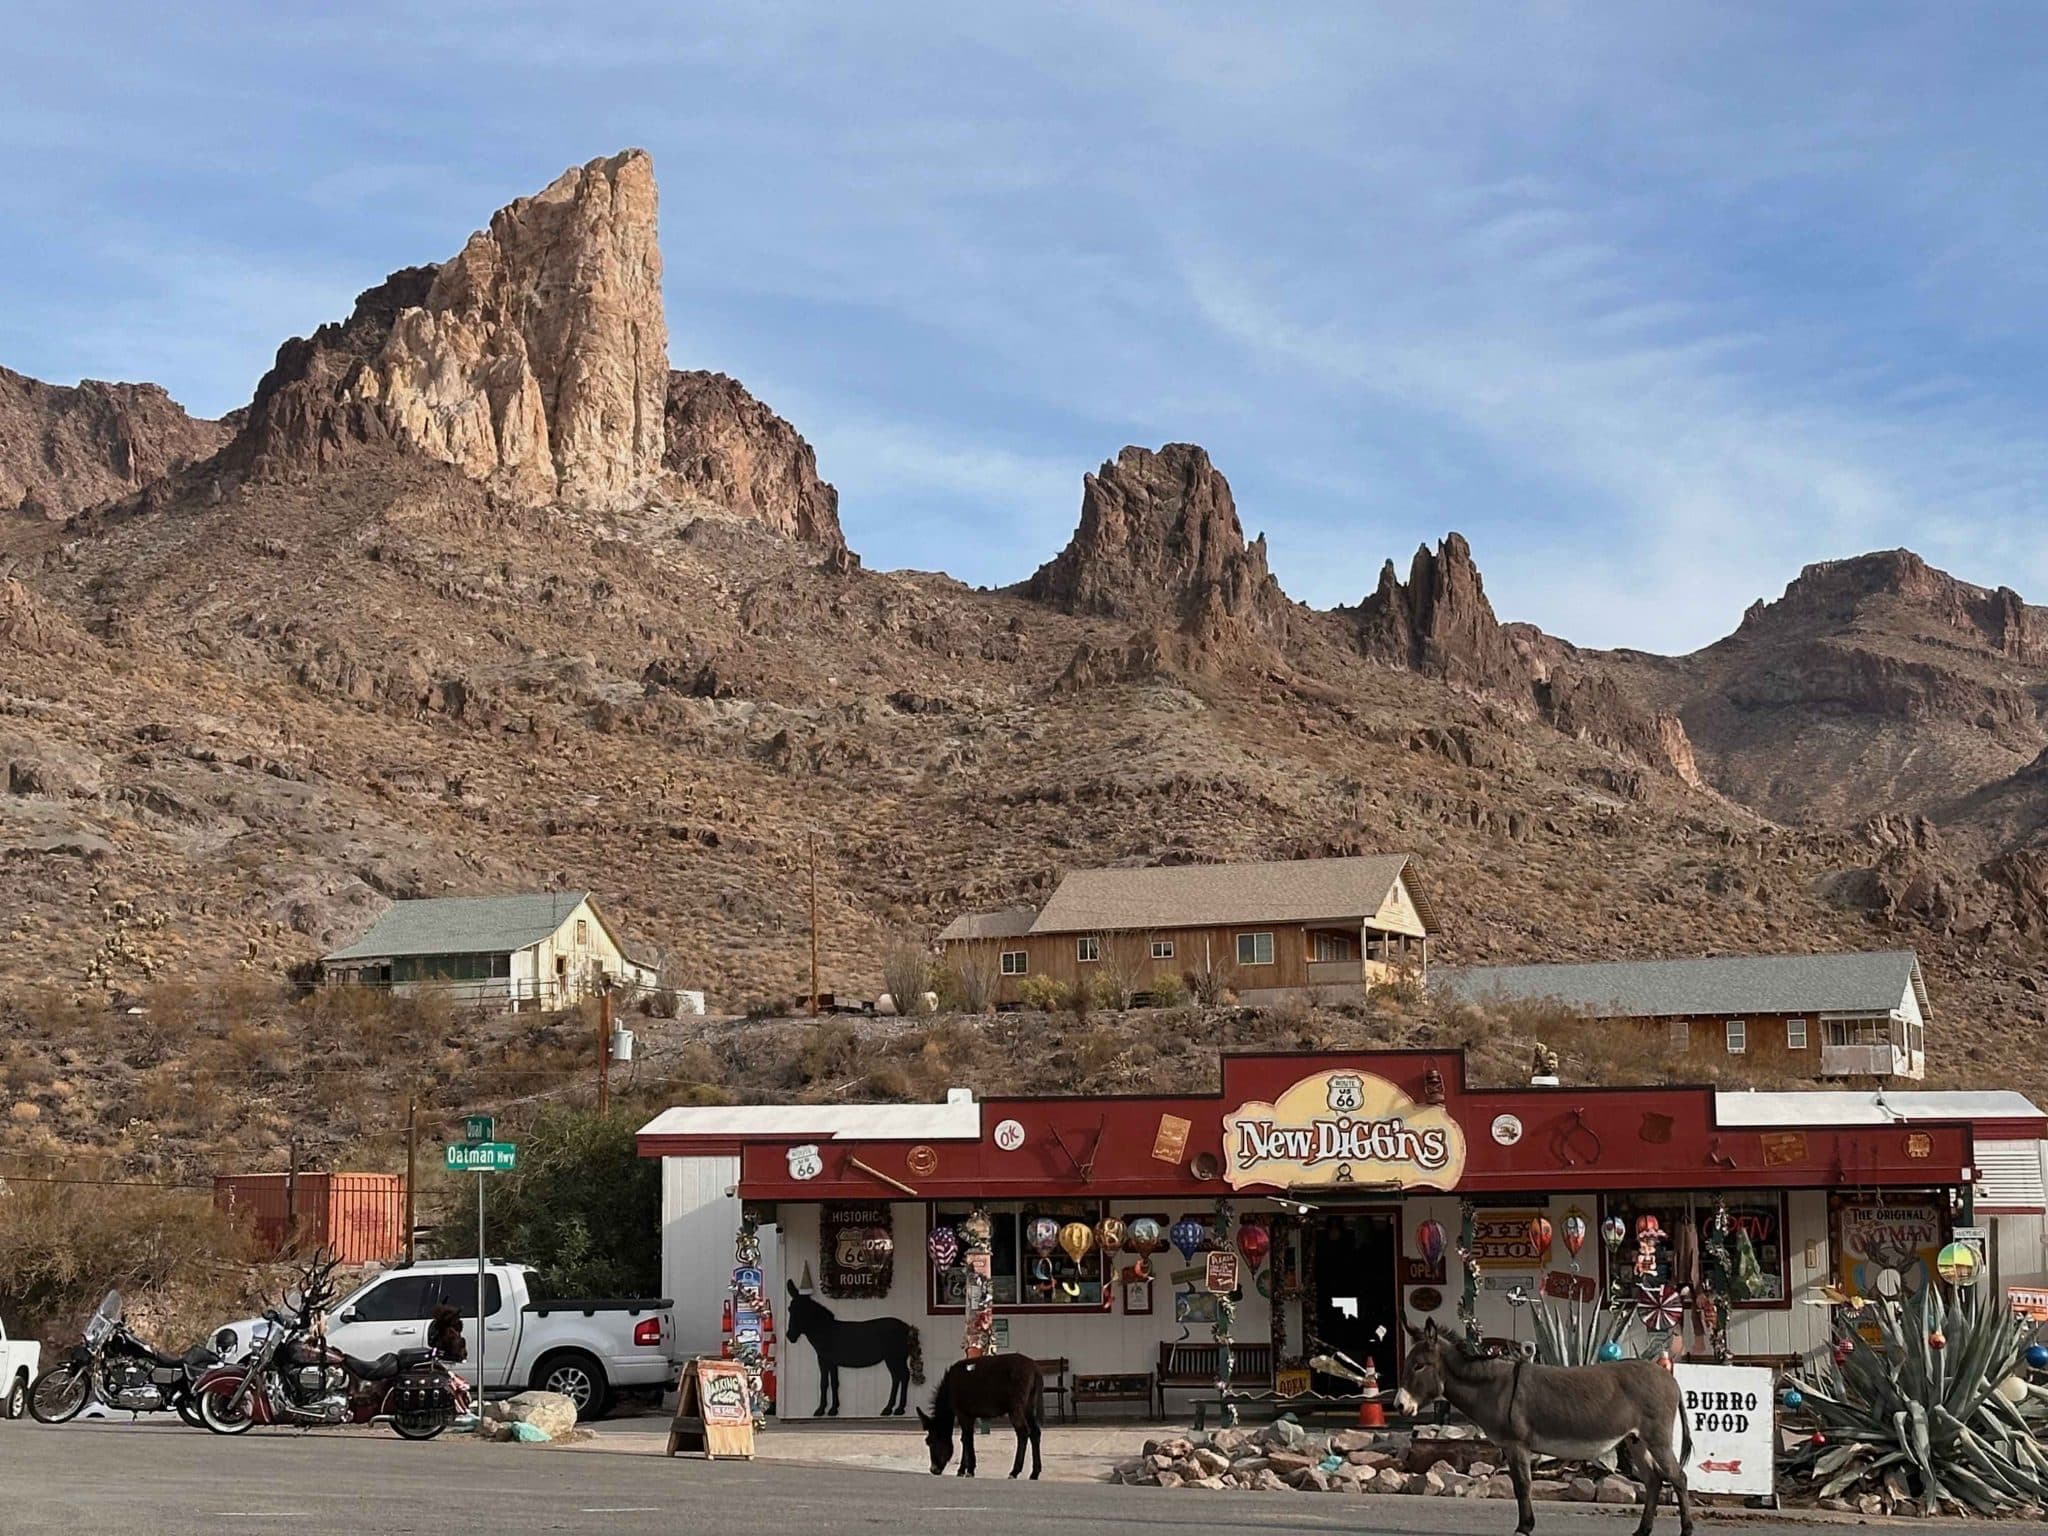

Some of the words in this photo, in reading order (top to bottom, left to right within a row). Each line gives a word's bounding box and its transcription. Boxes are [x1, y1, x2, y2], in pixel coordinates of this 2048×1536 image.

[1336, 1094, 1355, 1107] 66
[1000, 1125, 1019, 1147] OK
[1236, 1121, 1314, 1169] New
[447, 1146, 494, 1164] Oatman
[497, 1151, 514, 1166] Hwy
[797, 1162, 815, 1177] 66
[833, 1210, 880, 1223] HISTORIC
[1876, 1208, 1926, 1221] ORIGINAL
[840, 1273, 873, 1286] ROUTE
[1686, 1390, 1758, 1411] BURRO
[1694, 1412, 1750, 1434] FOOD
